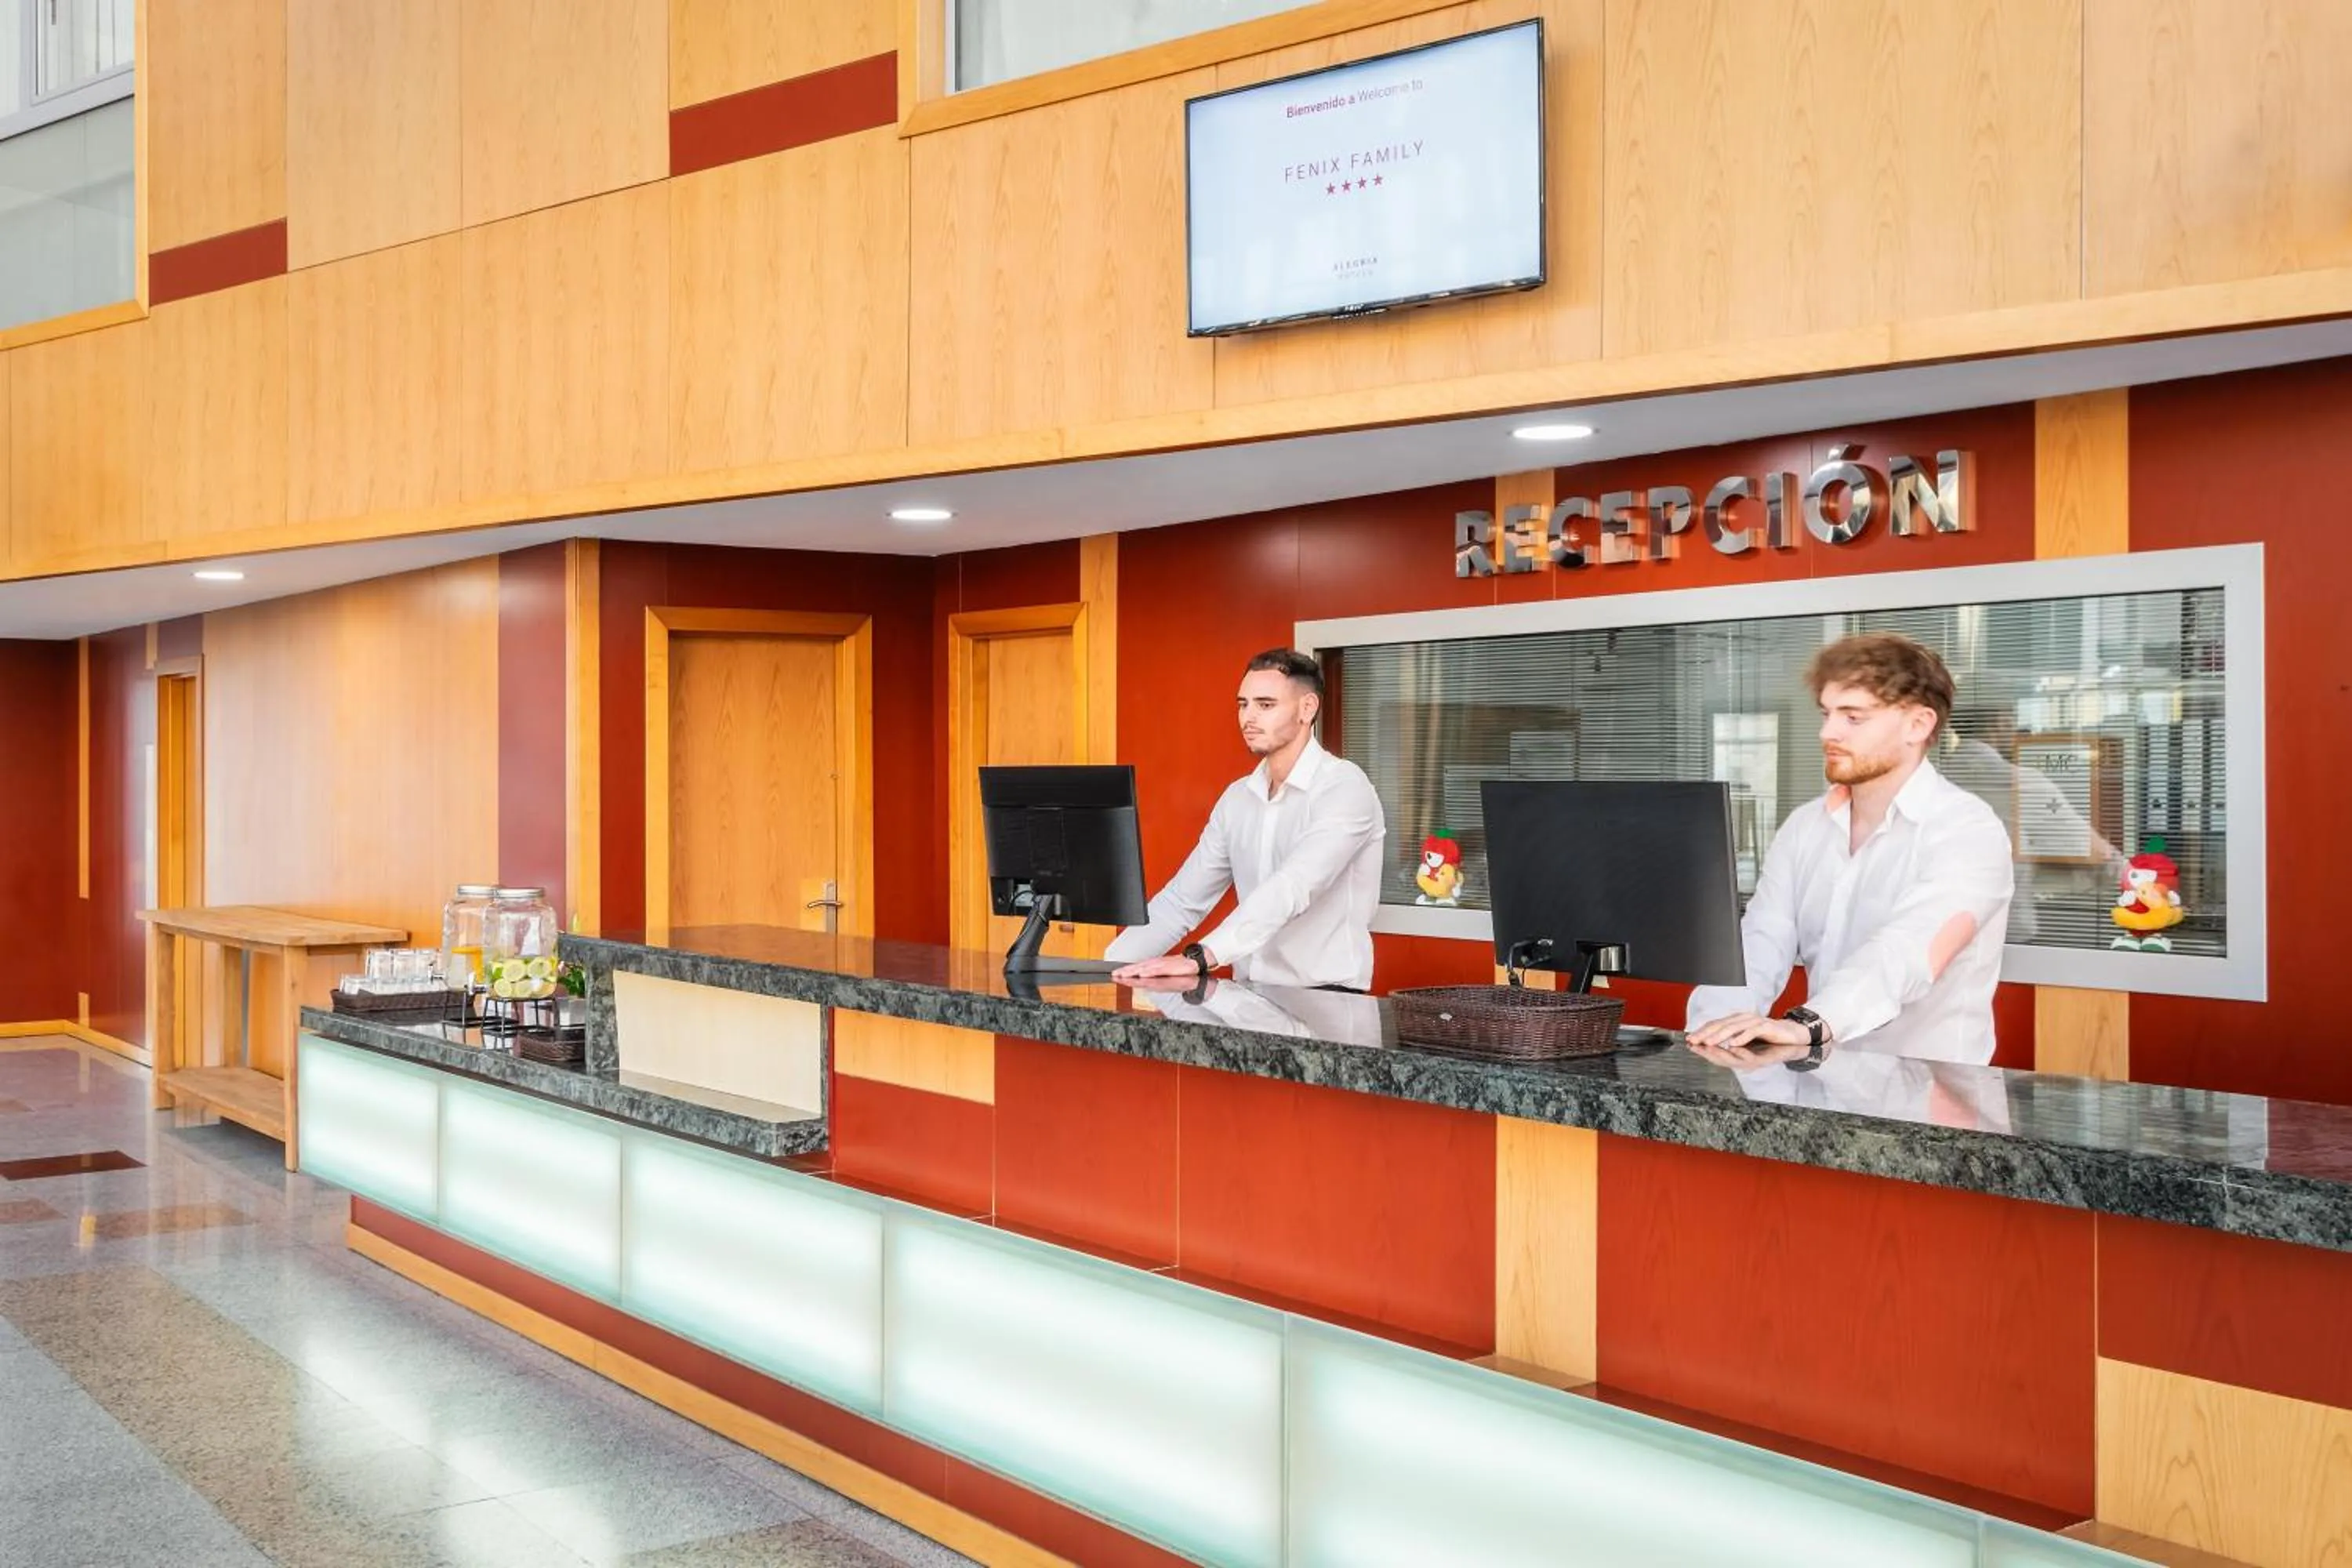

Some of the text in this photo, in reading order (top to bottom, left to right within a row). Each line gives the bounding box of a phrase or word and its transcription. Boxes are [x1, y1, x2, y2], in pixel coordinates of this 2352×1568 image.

[1287, 79, 1423, 118] Bienvenido a Welcome to
[1284, 140, 1424, 183] FENIX FAMILY
[1455, 443, 1965, 578] RECEPCIÓN
